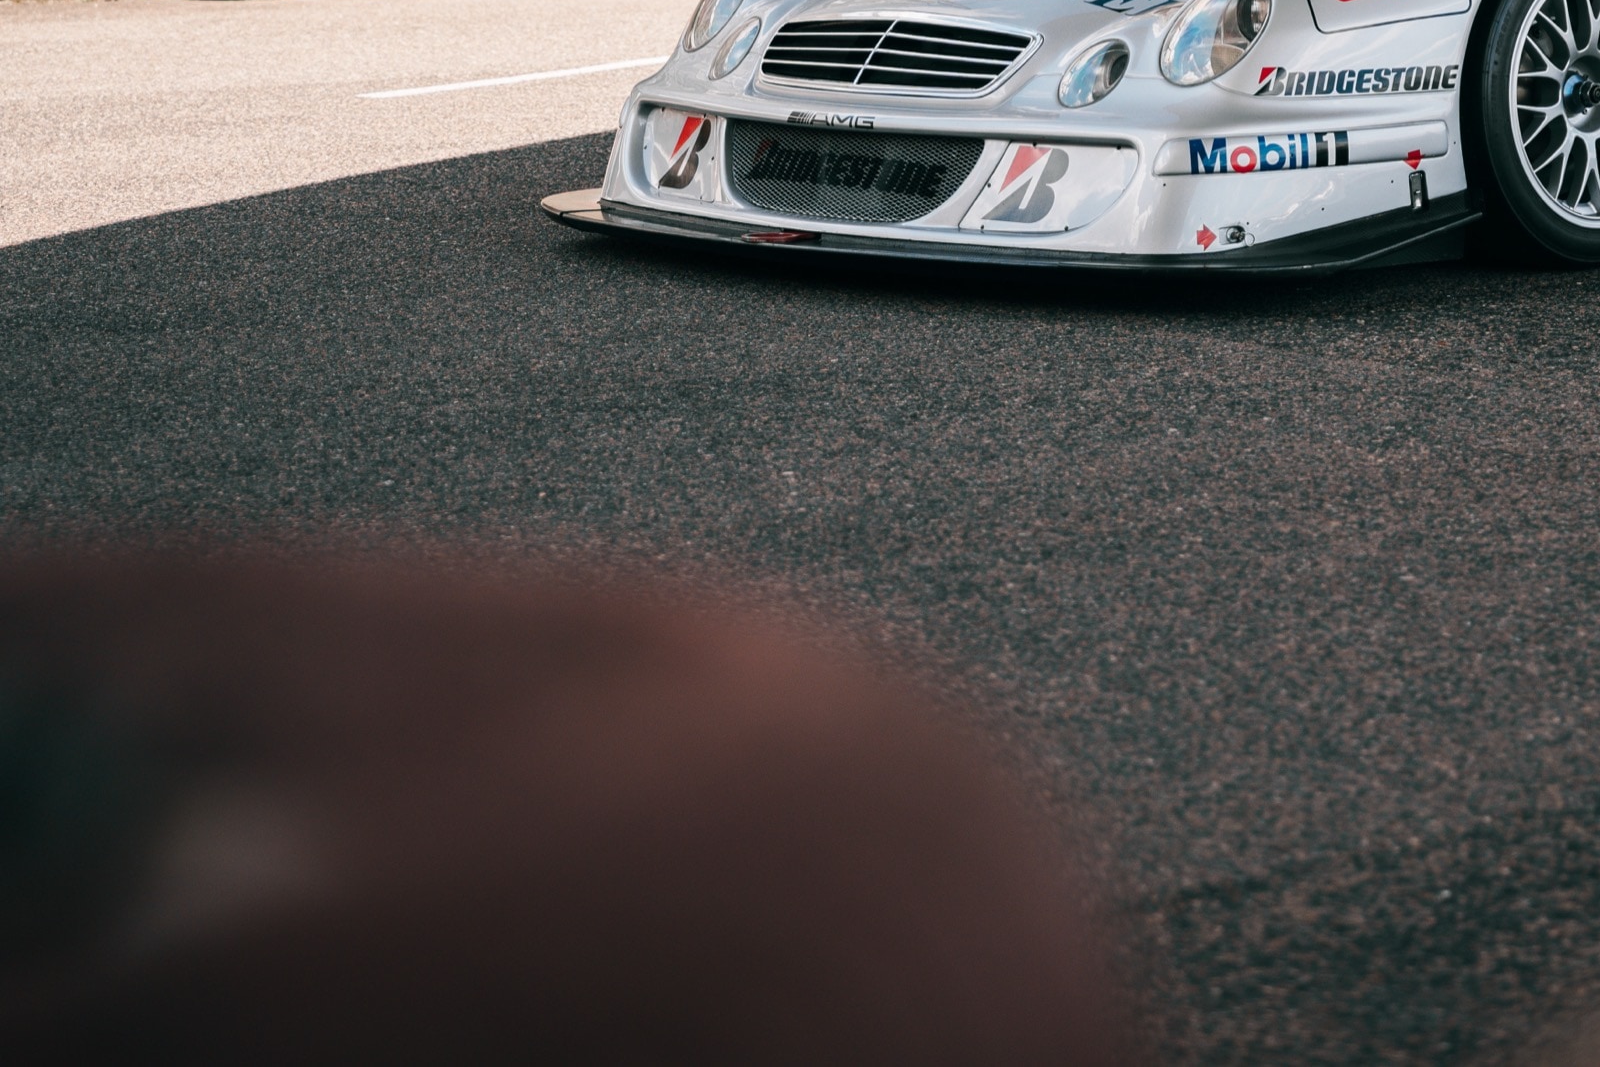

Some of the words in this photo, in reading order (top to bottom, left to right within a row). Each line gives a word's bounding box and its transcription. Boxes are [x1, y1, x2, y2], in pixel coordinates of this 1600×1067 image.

[1253, 65, 1459, 96] BRIDGESTONE
[811, 112, 876, 129] AMG
[1188, 133, 1309, 175] Mobil
